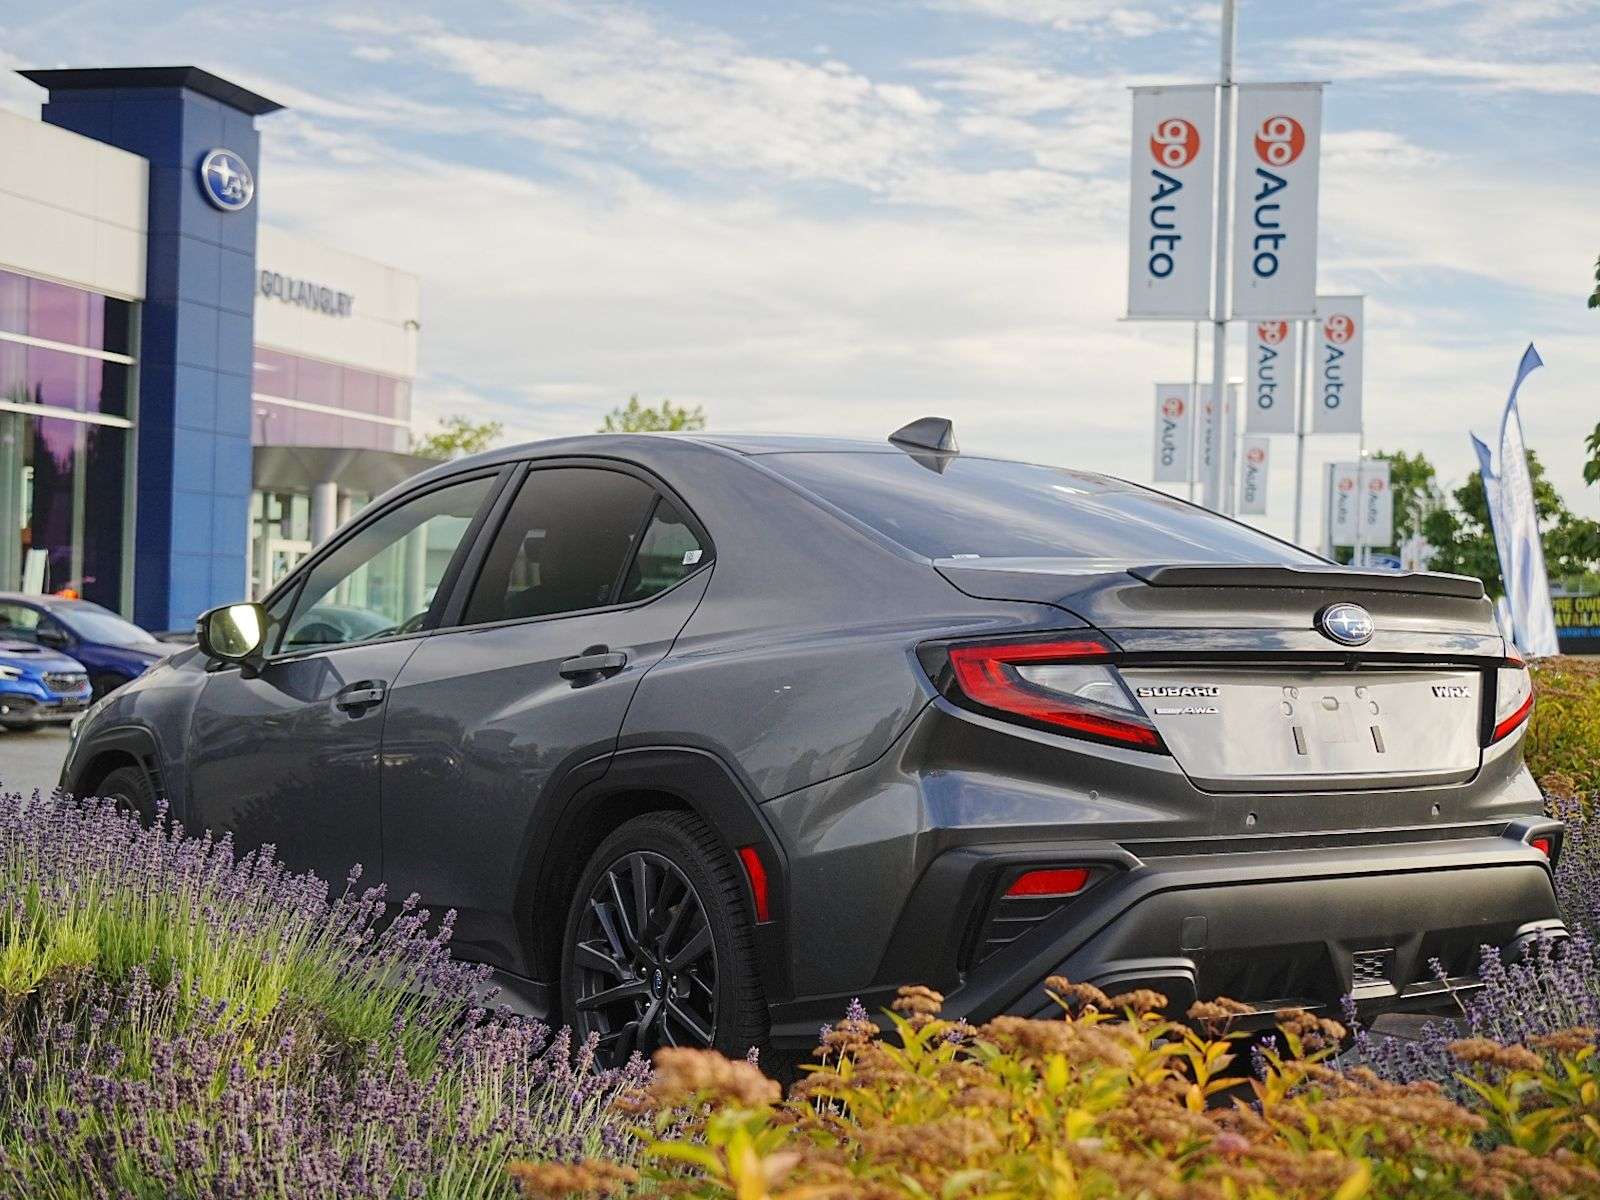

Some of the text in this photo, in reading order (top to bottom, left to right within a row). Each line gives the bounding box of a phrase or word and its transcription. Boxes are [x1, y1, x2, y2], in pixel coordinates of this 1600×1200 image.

[1149, 168, 1184, 278] Auto
[1253, 167, 1288, 278] Auto
[1258, 344, 1278, 410] Auto
[1324, 344, 1345, 410] Auto
[1136, 686, 1221, 698] SUBARU
[1431, 686, 1472, 698] WRX
